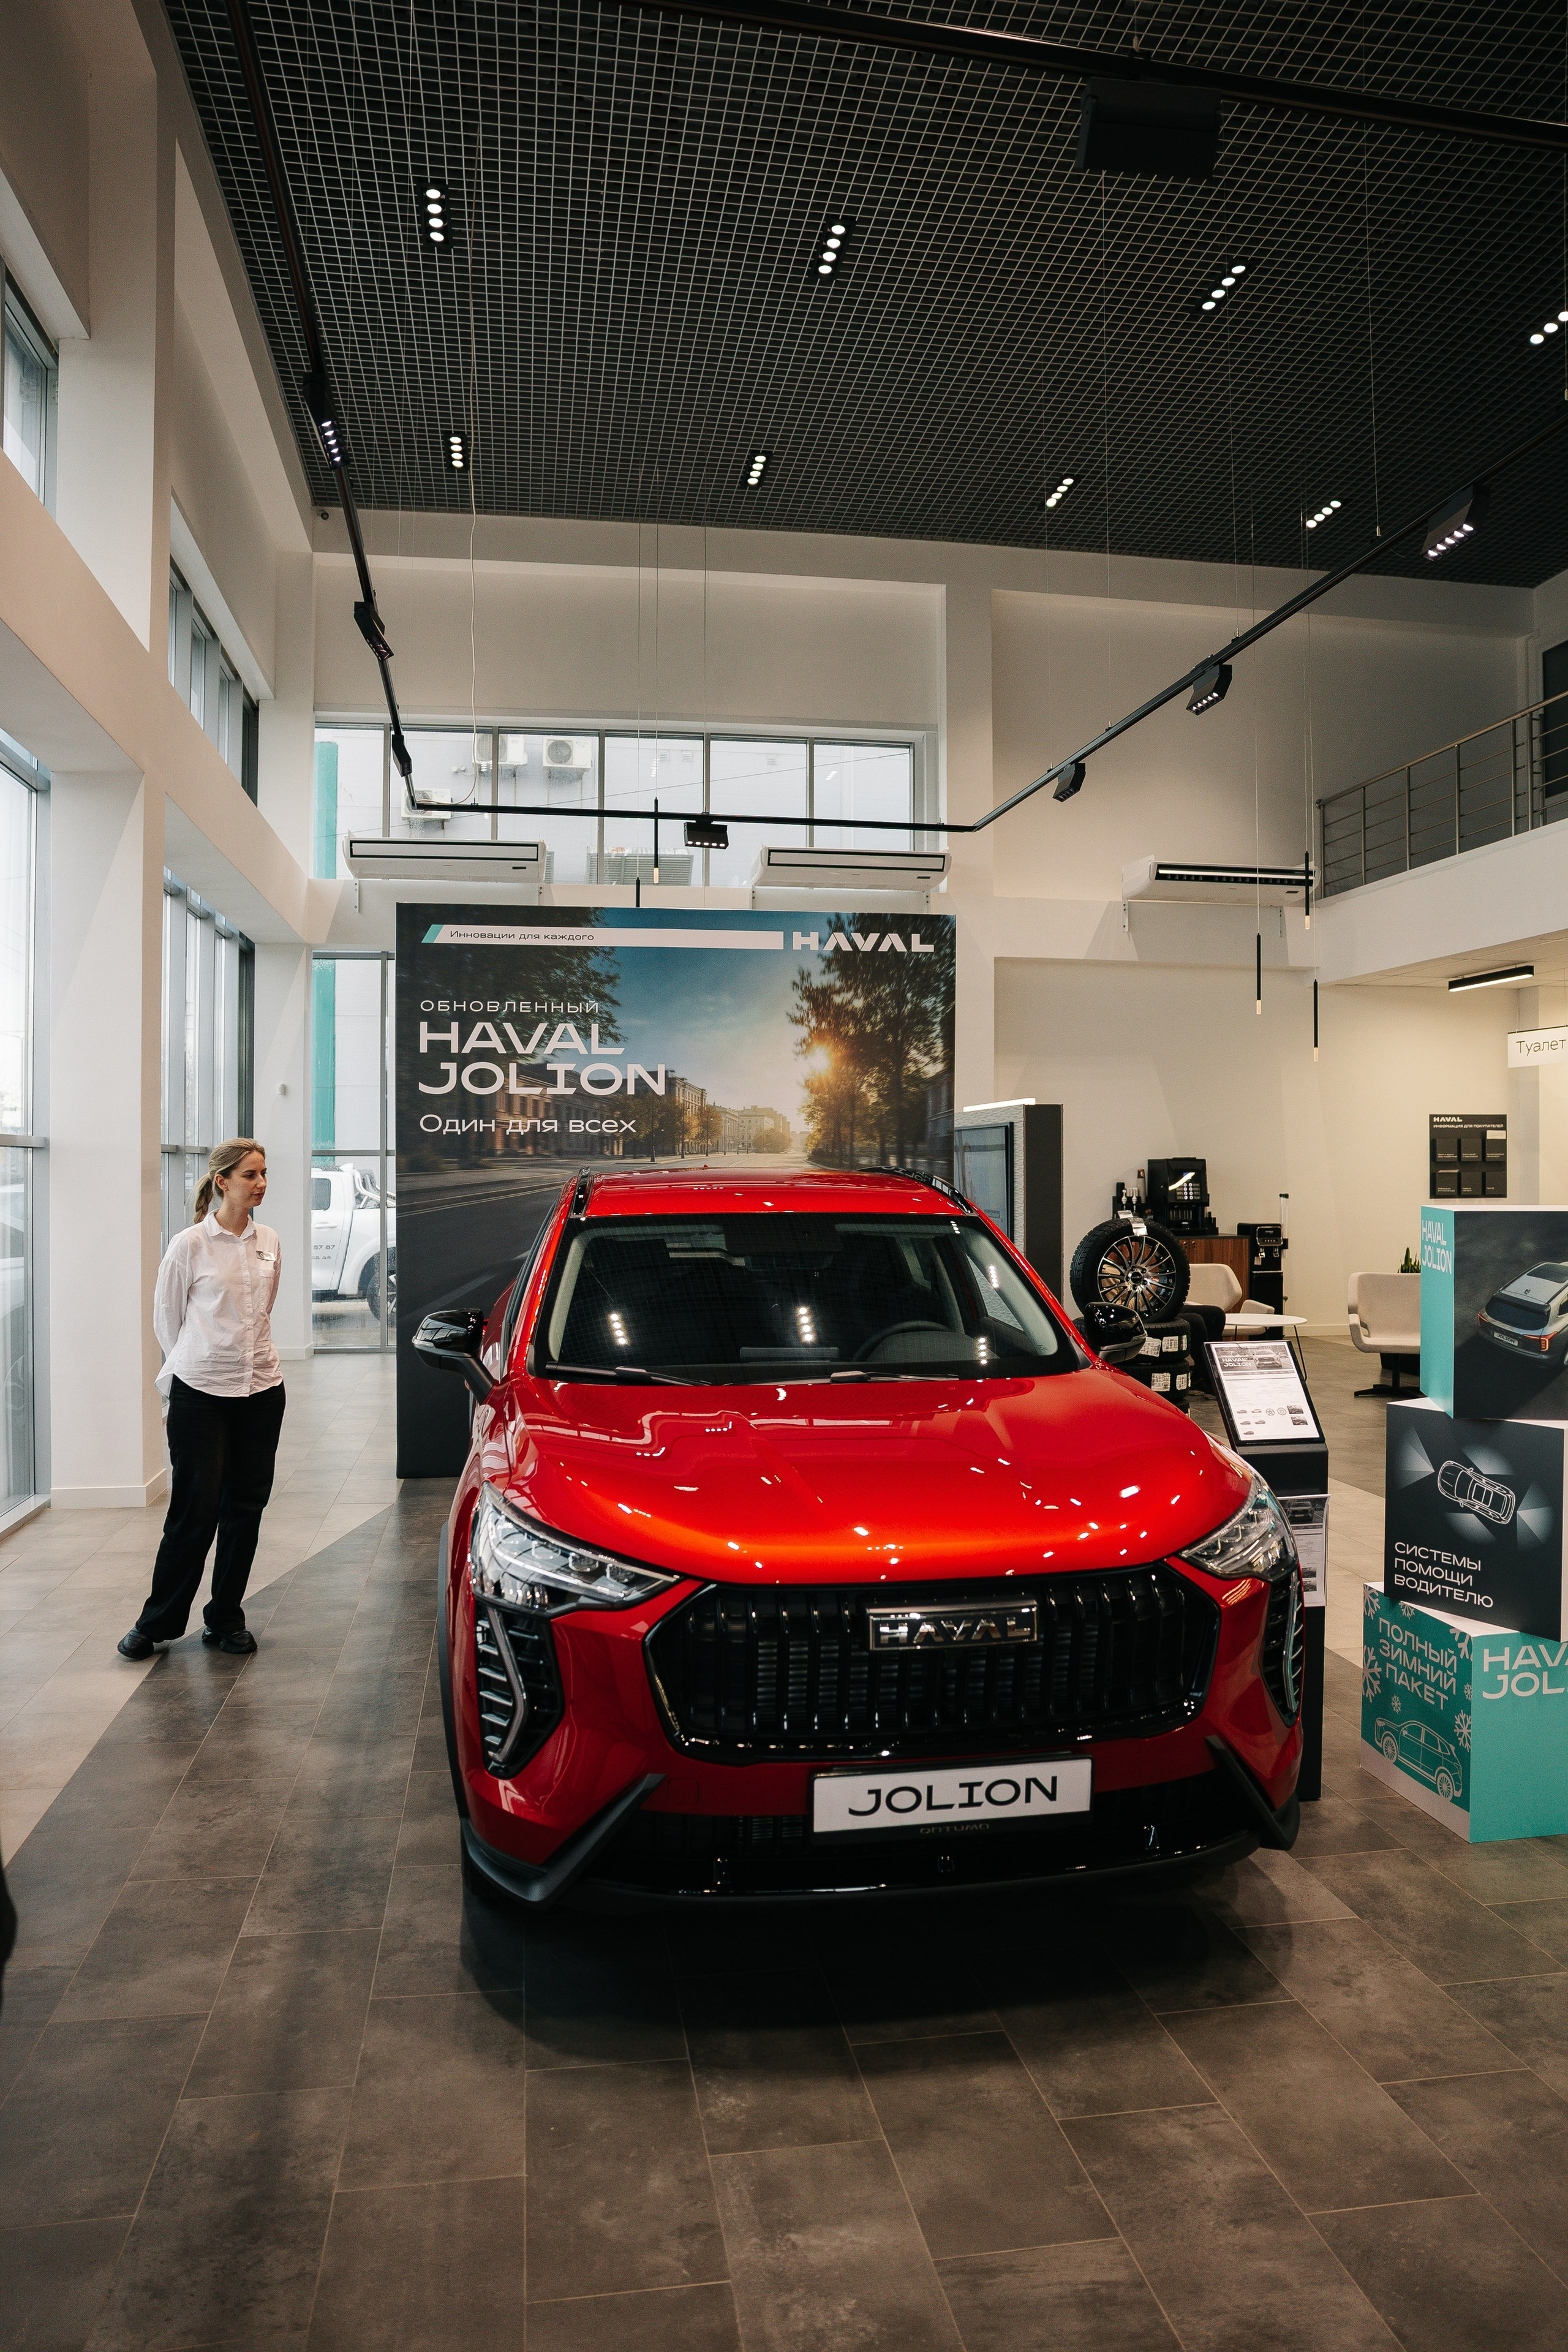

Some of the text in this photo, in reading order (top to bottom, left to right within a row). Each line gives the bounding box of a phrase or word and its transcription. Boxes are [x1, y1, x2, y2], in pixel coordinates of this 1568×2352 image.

[450, 930, 516, 940] Инновации
[792, 931, 935, 952] HAVAL
[420, 1000, 599, 1014] ОБНОВЛЕННЫЙ
[419, 1021, 625, 1055] HAVAL
[1516, 1039, 1567, 1057] Туалет
[418, 1061, 666, 1096] JOLION
[419, 1114, 636, 1135] Один для всех
[1422, 1219, 1447, 1246] HAVAL
[1422, 1245, 1452, 1275] JOLION
[1395, 1542, 1481, 1571] СИСТЕМЫ
[1395, 1558, 1472, 1586] ПОМОЩИ
[1394, 1574, 1494, 1608] ВОДИТЕЛЮ
[880, 1616, 1031, 1644] HAVAL
[1379, 1617, 1457, 1673] ПОЛНЫЙ
[1483, 1643, 1568, 1672] HAV
[1379, 1638, 1457, 1695] ЗИМНИЙ
[1386, 1662, 1449, 1710] ПАКЕТ
[1482, 1671, 1568, 1700] JOL
[848, 1776, 1058, 1817] JOLION
